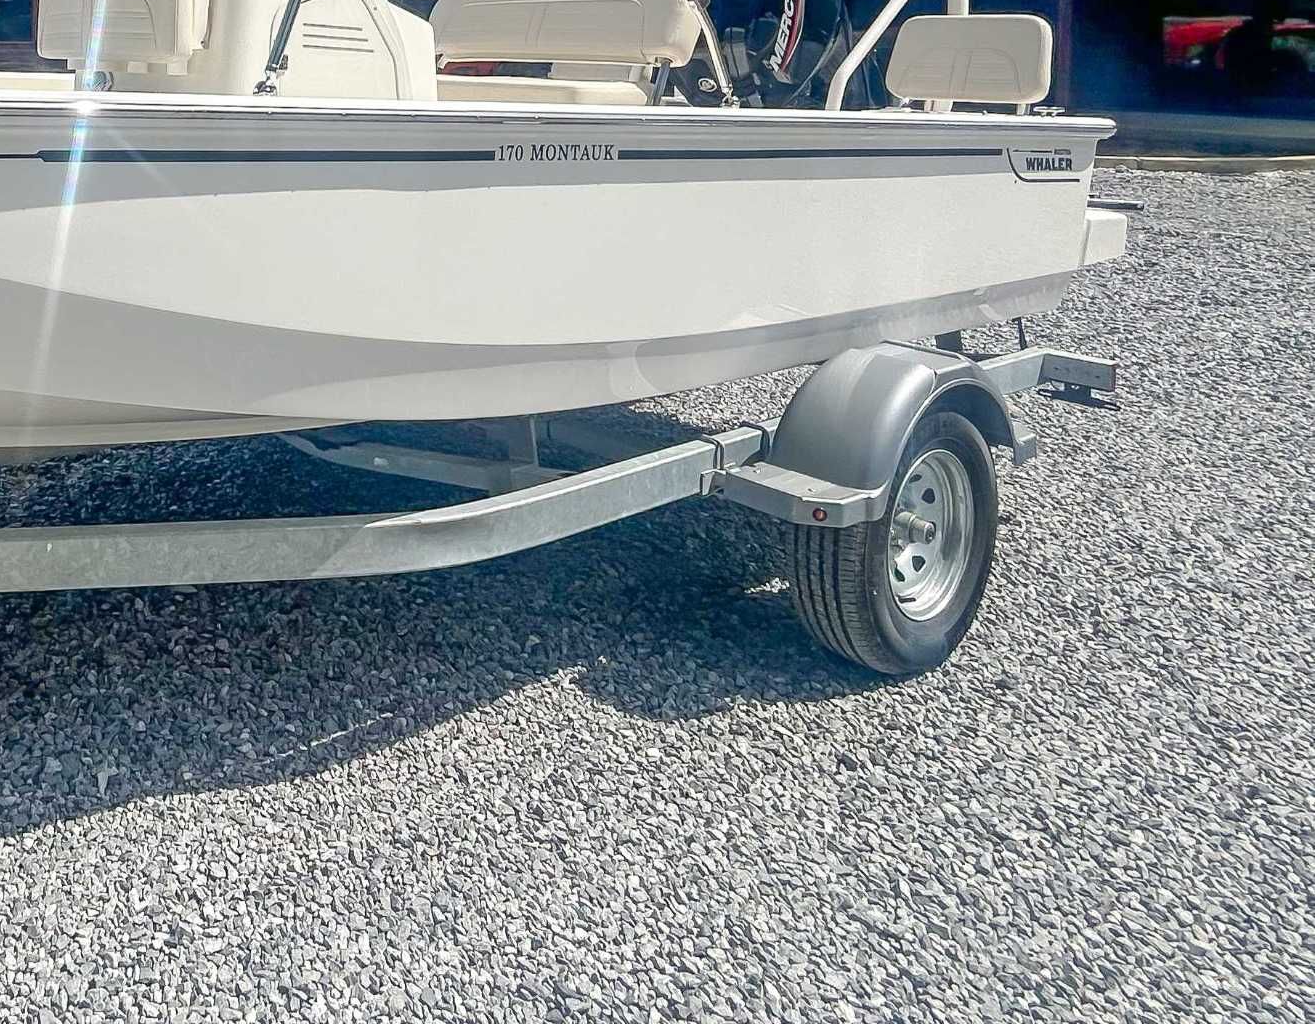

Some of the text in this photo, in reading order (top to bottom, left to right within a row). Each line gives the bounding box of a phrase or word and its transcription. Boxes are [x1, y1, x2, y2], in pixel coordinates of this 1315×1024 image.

[498, 144, 615, 161] 170 MONTAUK
[1025, 157, 1073, 171] WHALER
